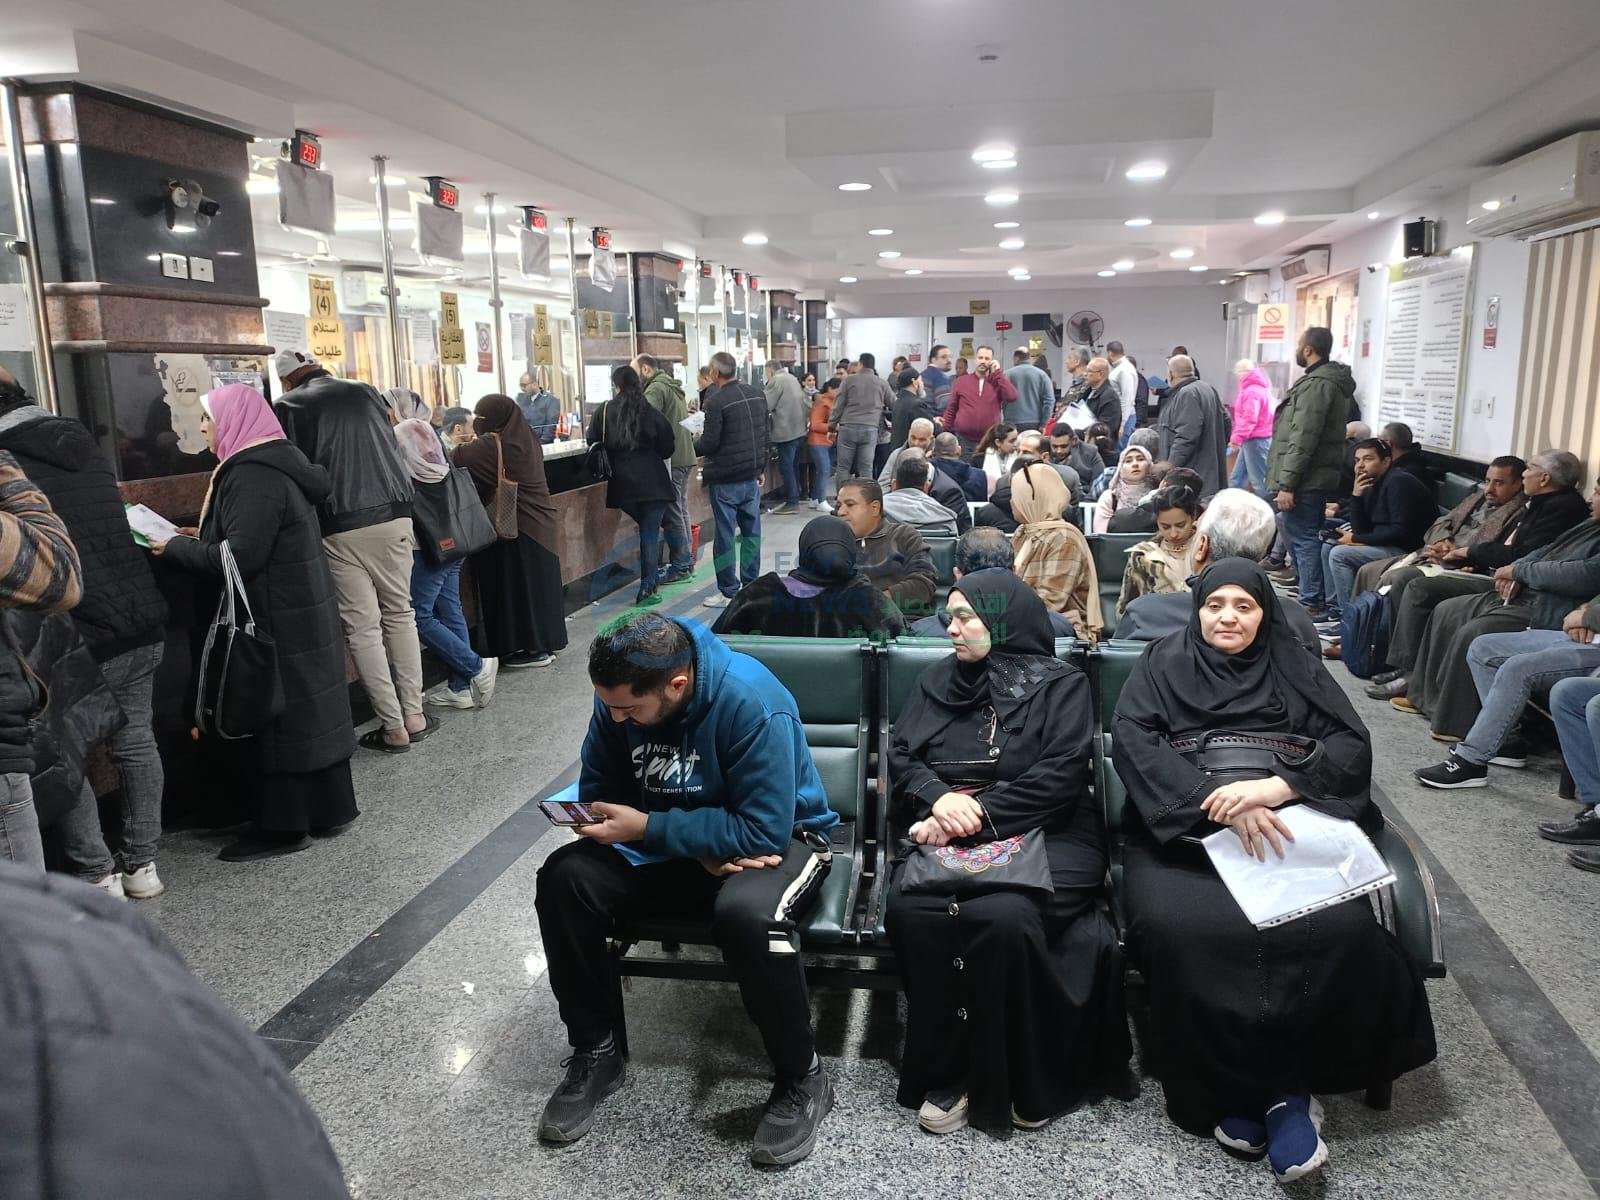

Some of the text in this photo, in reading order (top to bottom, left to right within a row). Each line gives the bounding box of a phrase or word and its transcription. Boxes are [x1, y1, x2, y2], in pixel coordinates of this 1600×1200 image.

[303, 144, 316, 162] 233
[316, 296, 331, 315] (4)
[446, 309, 456, 325] (5)
[313, 322, 339, 336] استلام
[313, 345, 342, 359] طلبات
[653, 744, 680, 754] NEW
[662, 785, 703, 794] GENERTION
